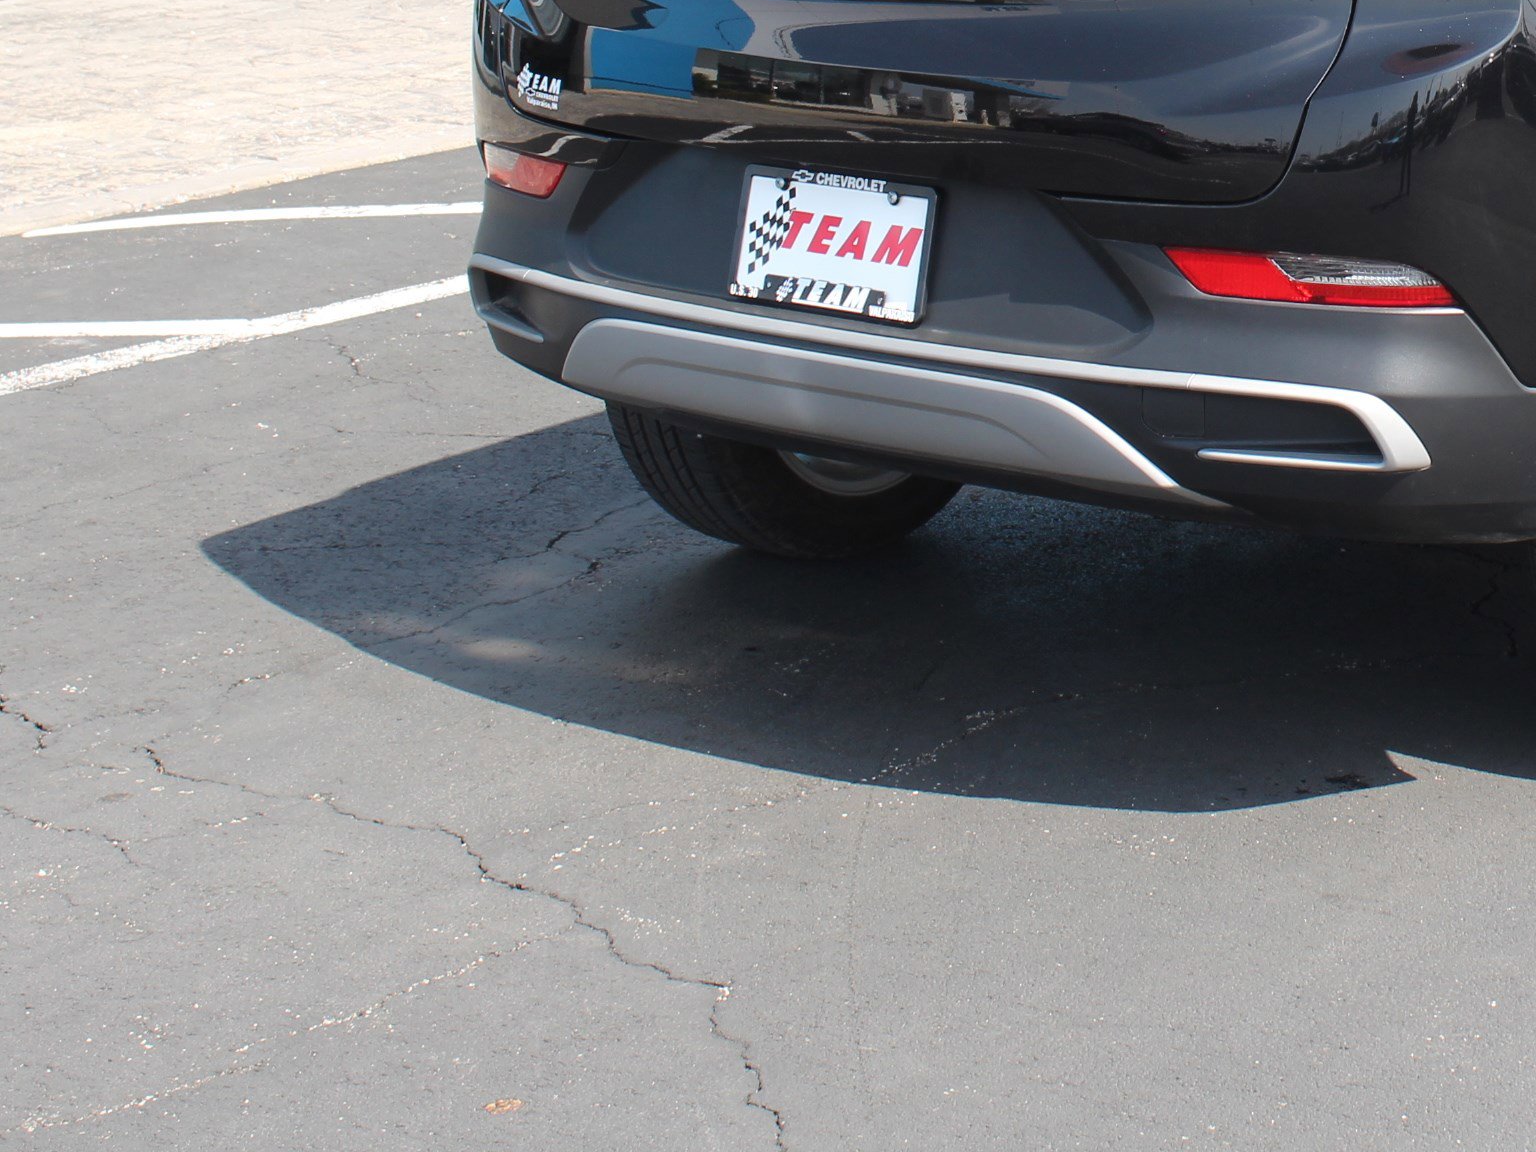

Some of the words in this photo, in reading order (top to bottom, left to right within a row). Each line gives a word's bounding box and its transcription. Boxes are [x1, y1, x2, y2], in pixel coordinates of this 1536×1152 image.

[816, 172, 887, 193] CHEVROLET
[781, 210, 924, 267] TEAM
[792, 277, 871, 312] TEAM
